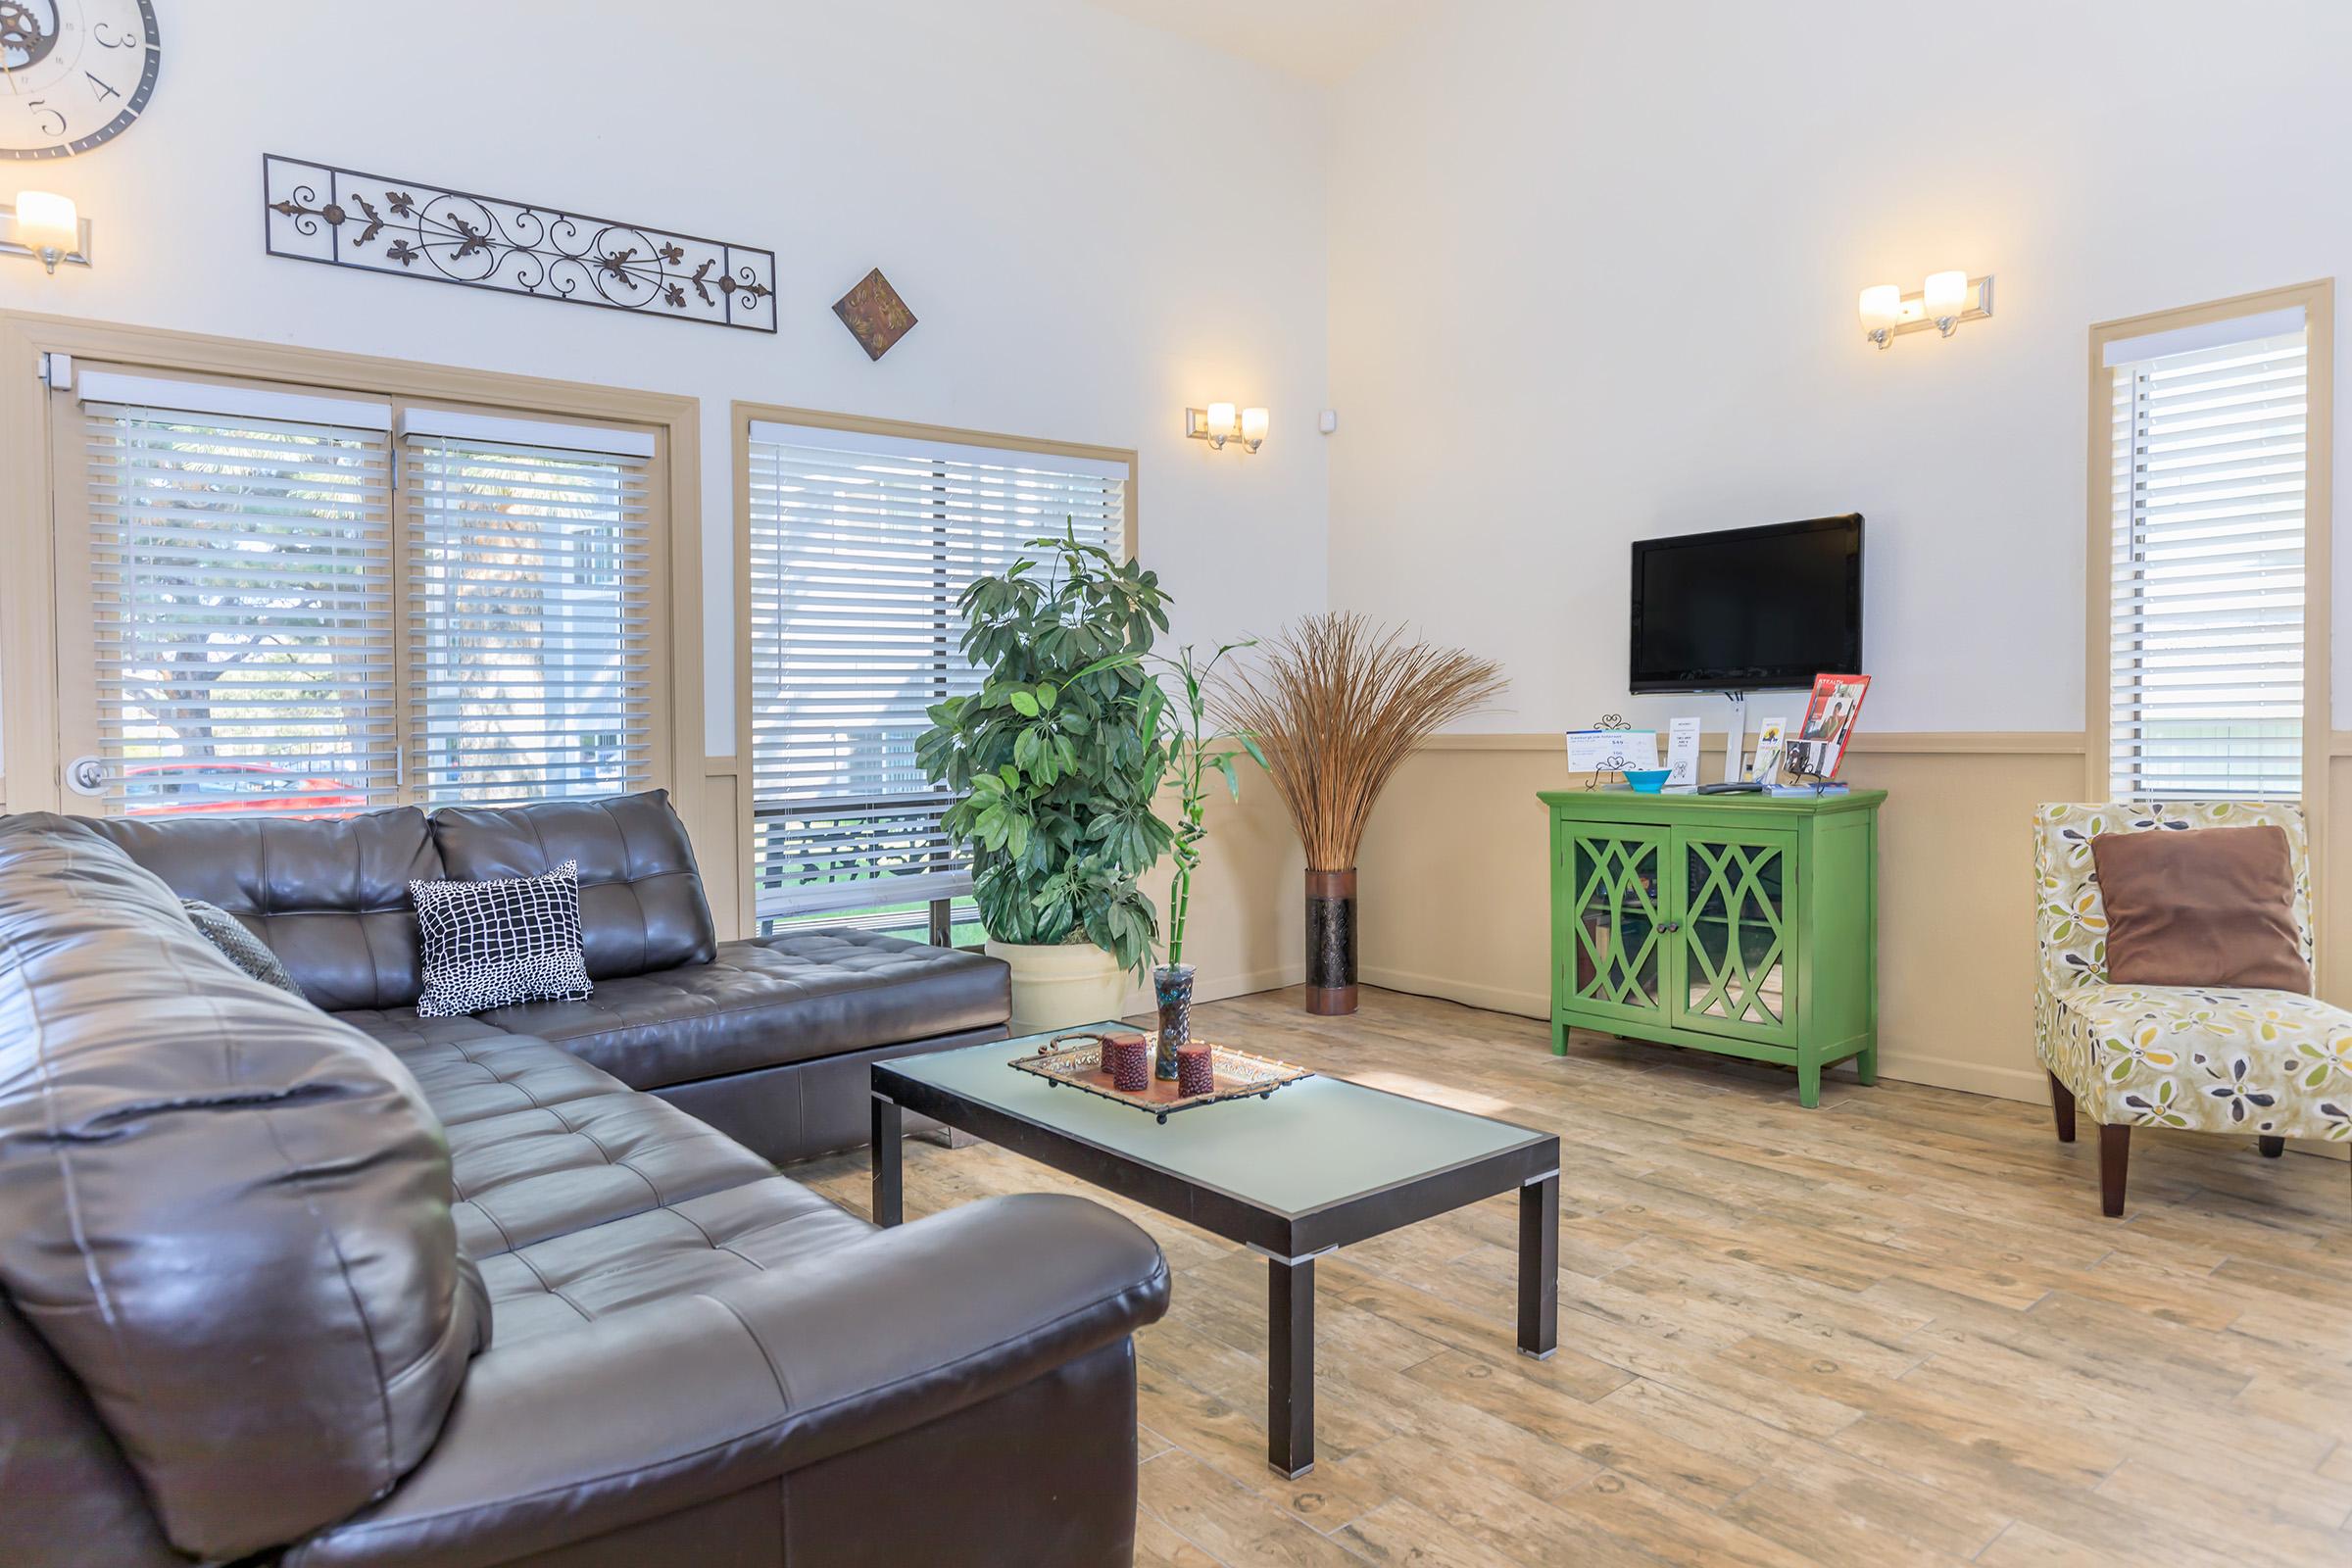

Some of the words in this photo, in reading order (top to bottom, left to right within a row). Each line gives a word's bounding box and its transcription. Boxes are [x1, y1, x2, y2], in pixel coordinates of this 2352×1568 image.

[94, 23, 136, 48] 3
[84, 71, 121, 102] 4
[28, 99, 67, 136] 5
